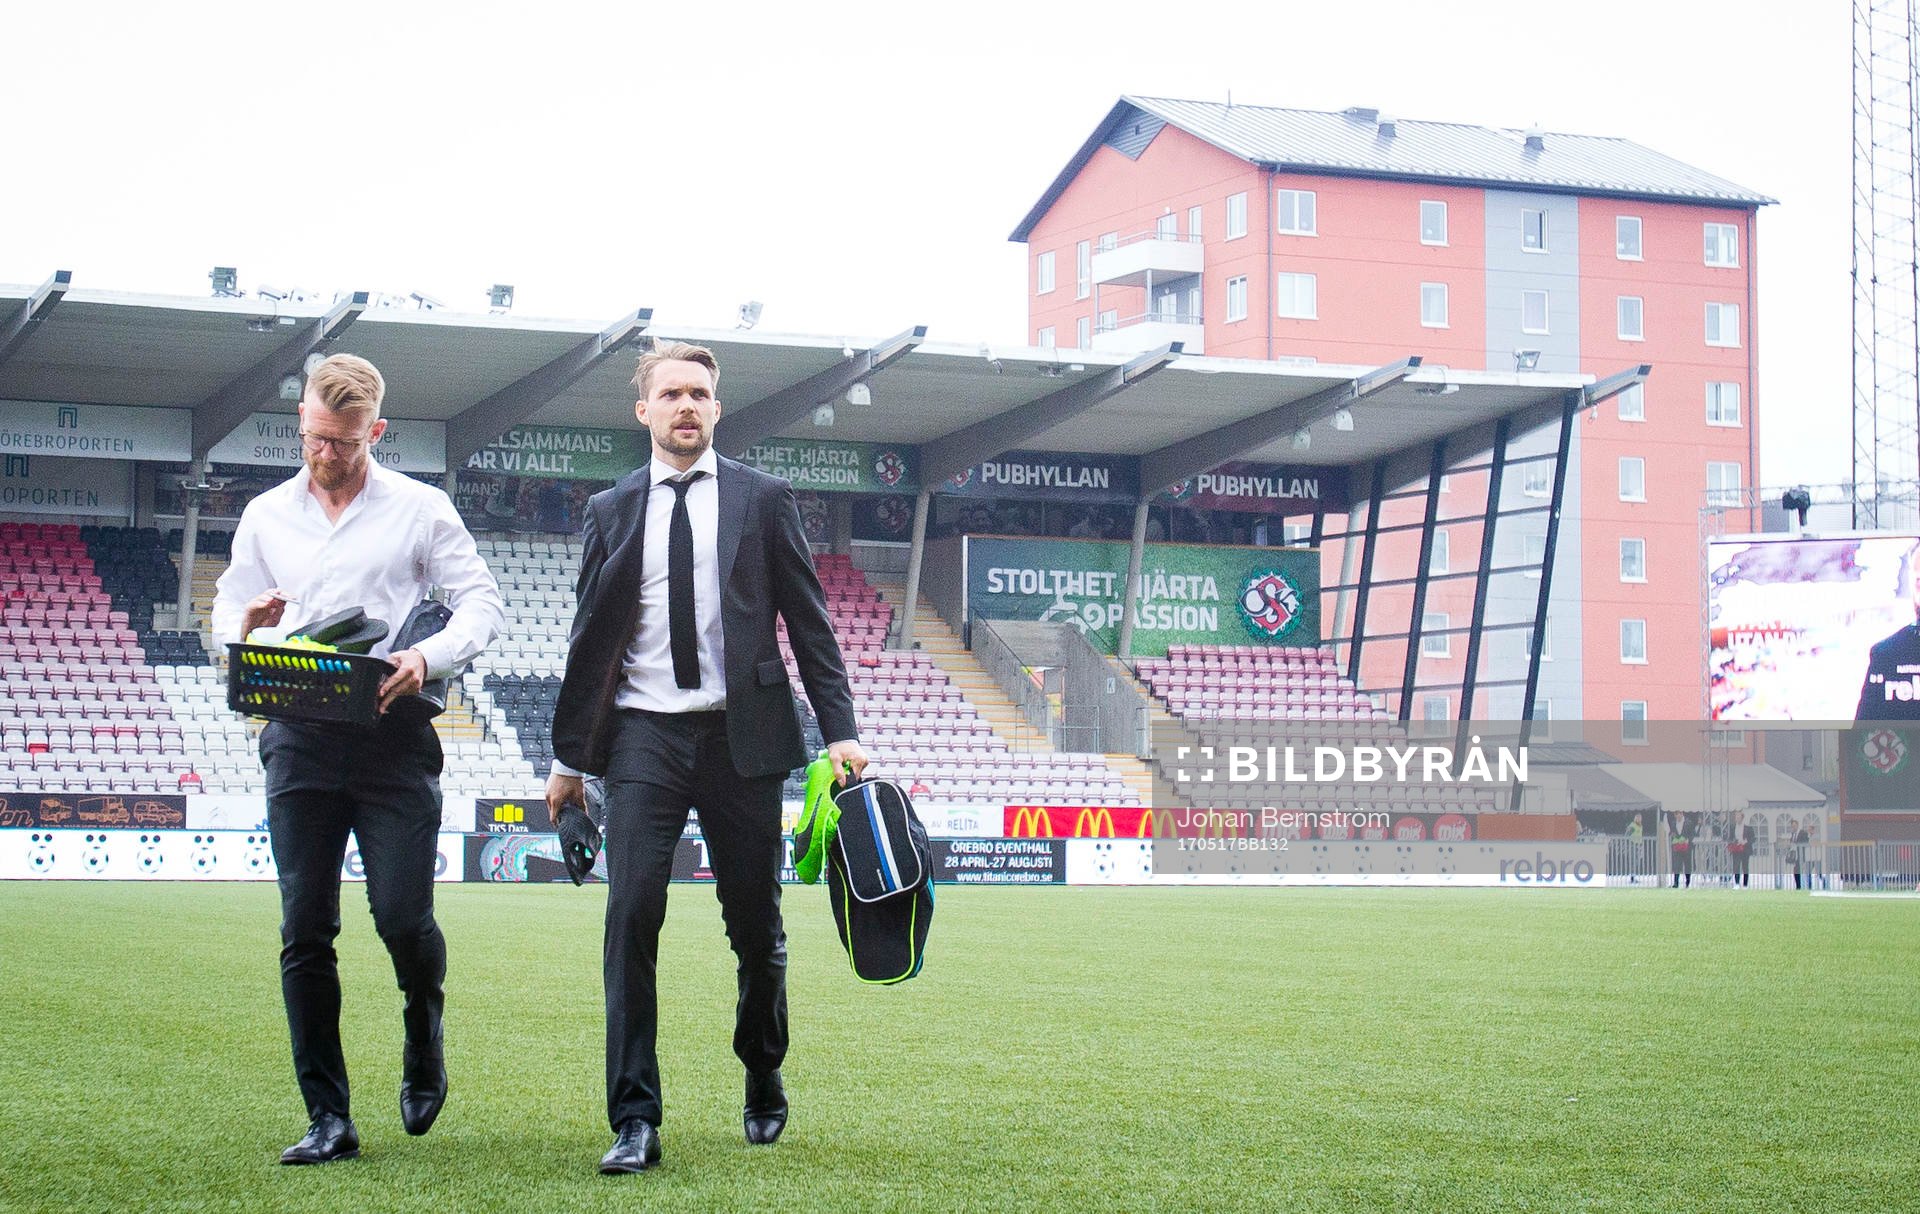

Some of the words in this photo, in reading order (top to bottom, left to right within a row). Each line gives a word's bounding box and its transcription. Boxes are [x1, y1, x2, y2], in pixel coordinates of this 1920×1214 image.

[256, 421, 271, 437] Vi
[275, 424, 302, 439] utv
[0, 430, 134, 453] ÖREBROPORTEN
[488, 431, 612, 453] LSAMMANS
[253, 447, 285, 460] som
[501, 452, 521, 471] VI
[525, 453, 574, 473] ALLT.
[800, 446, 860, 467] HJÄRTA
[789, 467, 859, 484] PASSION
[982, 462, 1109, 488] PUBHYLLAN
[1198, 474, 1319, 499] PUBHYLLAN
[987, 568, 1119, 600] STOLTHET,
[951, 841, 994, 854] ÖREBRO
[995, 842, 1053, 854] EVENTHALL
[944, 857, 959, 867] 28
[960, 857, 1006, 868] APRIL-27
[1500, 851, 1594, 882] rebro
